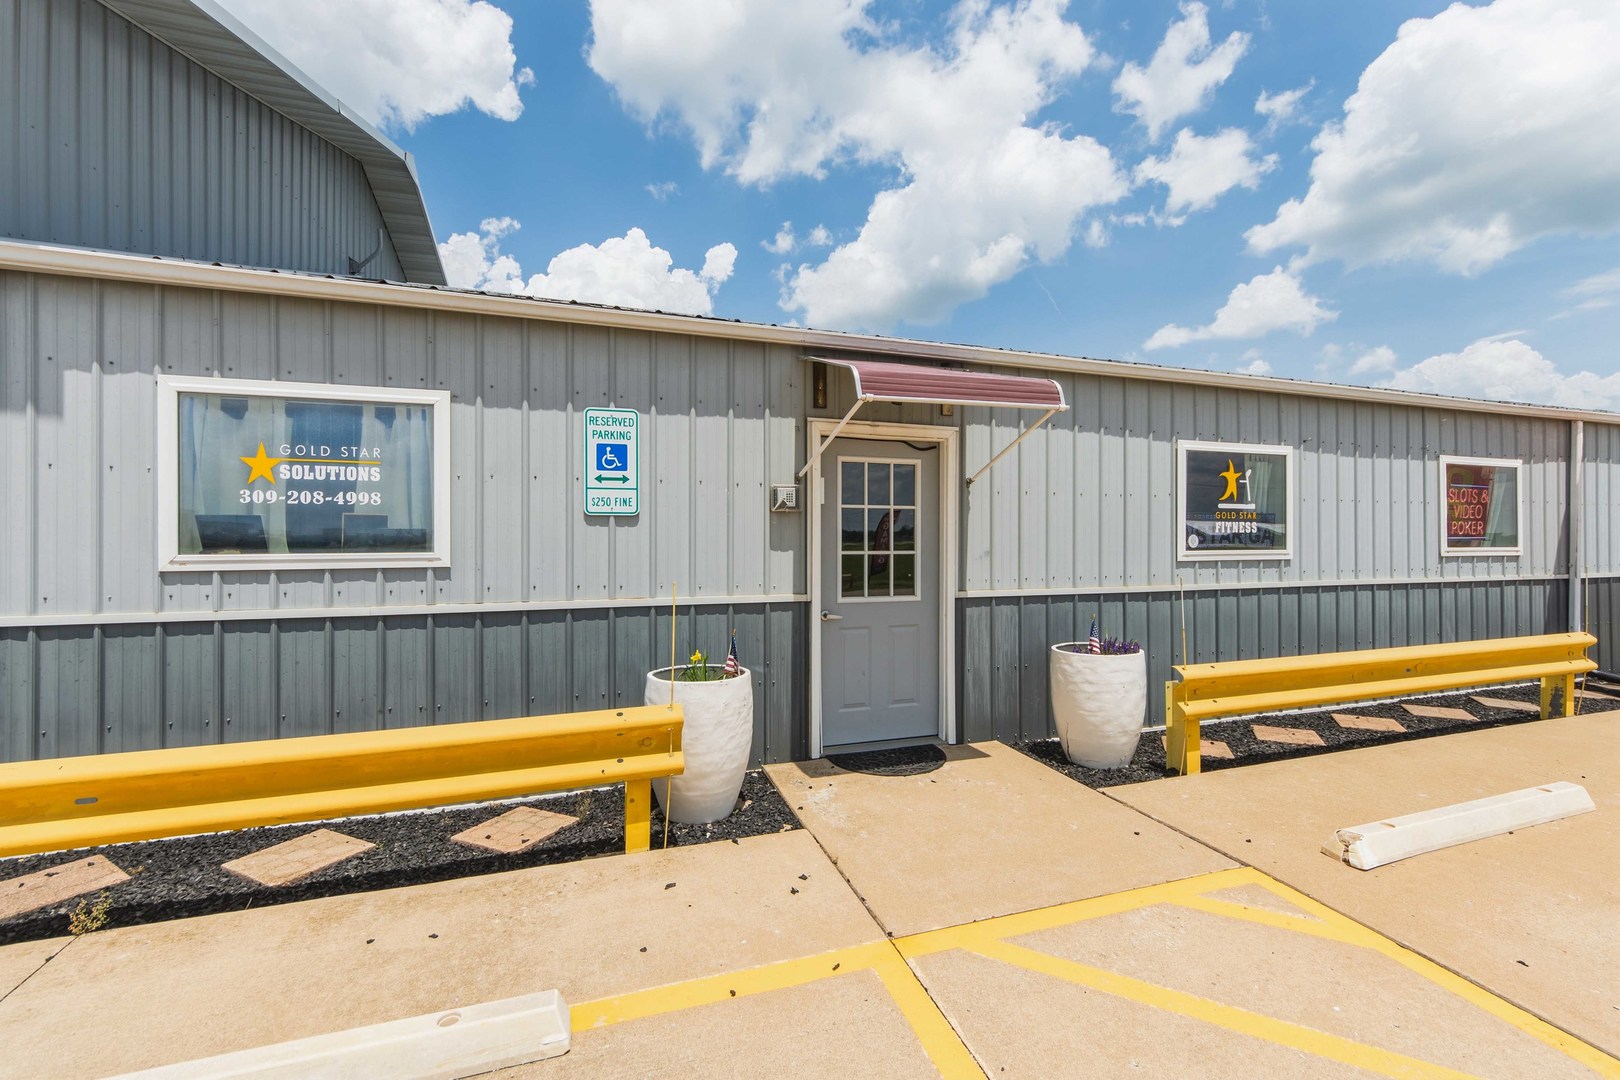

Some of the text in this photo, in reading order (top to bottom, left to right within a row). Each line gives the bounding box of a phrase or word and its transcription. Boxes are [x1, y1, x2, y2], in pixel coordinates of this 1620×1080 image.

[588, 415, 635, 428] RESERVED
[591, 429, 632, 441] PARKING
[279, 444, 381, 458] GOLD STAR
[279, 464, 381, 482] SOLUTIONS
[239, 489, 382, 506] 309-208-4998
[591, 496, 633, 507] $250 FINE
[1448, 488, 1489, 503] SLOTS &
[1215, 511, 1237, 519] GOLD
[1239, 511, 1257, 520] STAR
[1453, 504, 1483, 519] VIDEO
[1215, 521, 1258, 533] FITNESS
[1451, 520, 1484, 535] POKER
